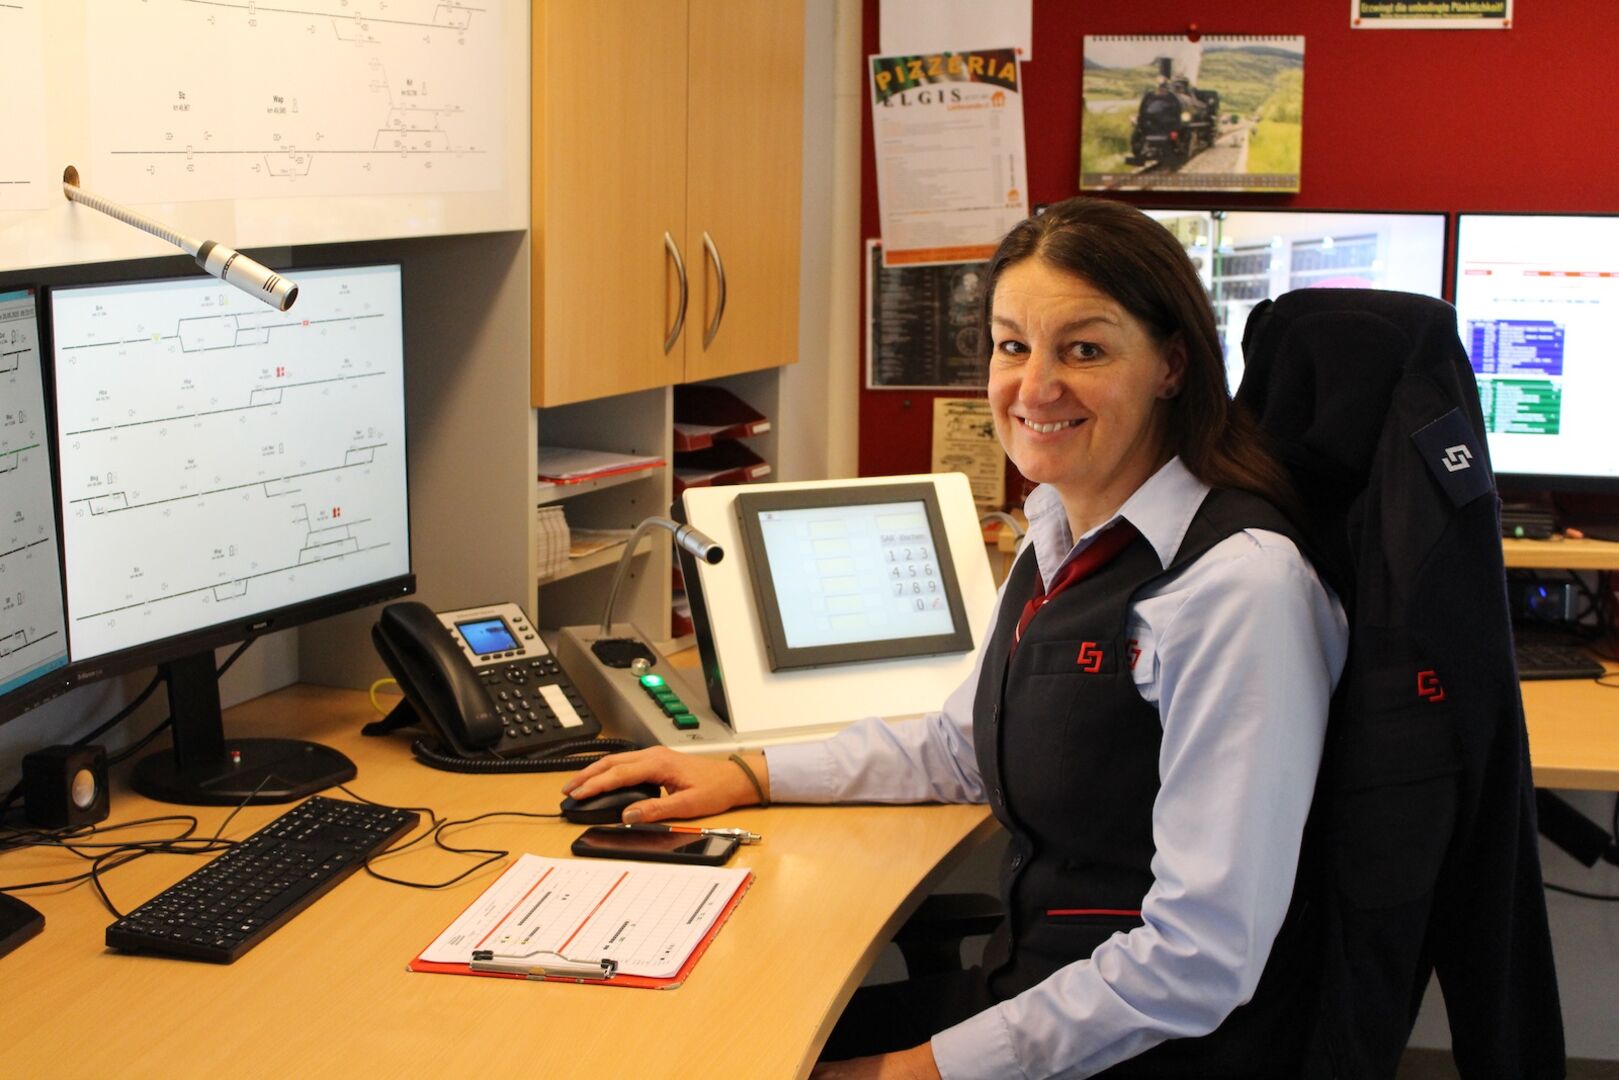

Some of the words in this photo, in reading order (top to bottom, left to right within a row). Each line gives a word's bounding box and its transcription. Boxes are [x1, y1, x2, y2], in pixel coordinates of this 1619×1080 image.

[875, 55, 1016, 91] PIZZERIA
[883, 88, 962, 107] ELGIS
[889, 550, 896, 562] 1
[904, 548, 912, 561] 2
[920, 547, 928, 560] 3
[892, 567, 900, 578] 4
[908, 565, 916, 577] 5
[924, 563, 932, 576] 6
[896, 582, 903, 595] 7
[912, 582, 920, 594] 8
[928, 580, 936, 592] 9
[916, 598, 924, 610] 0
